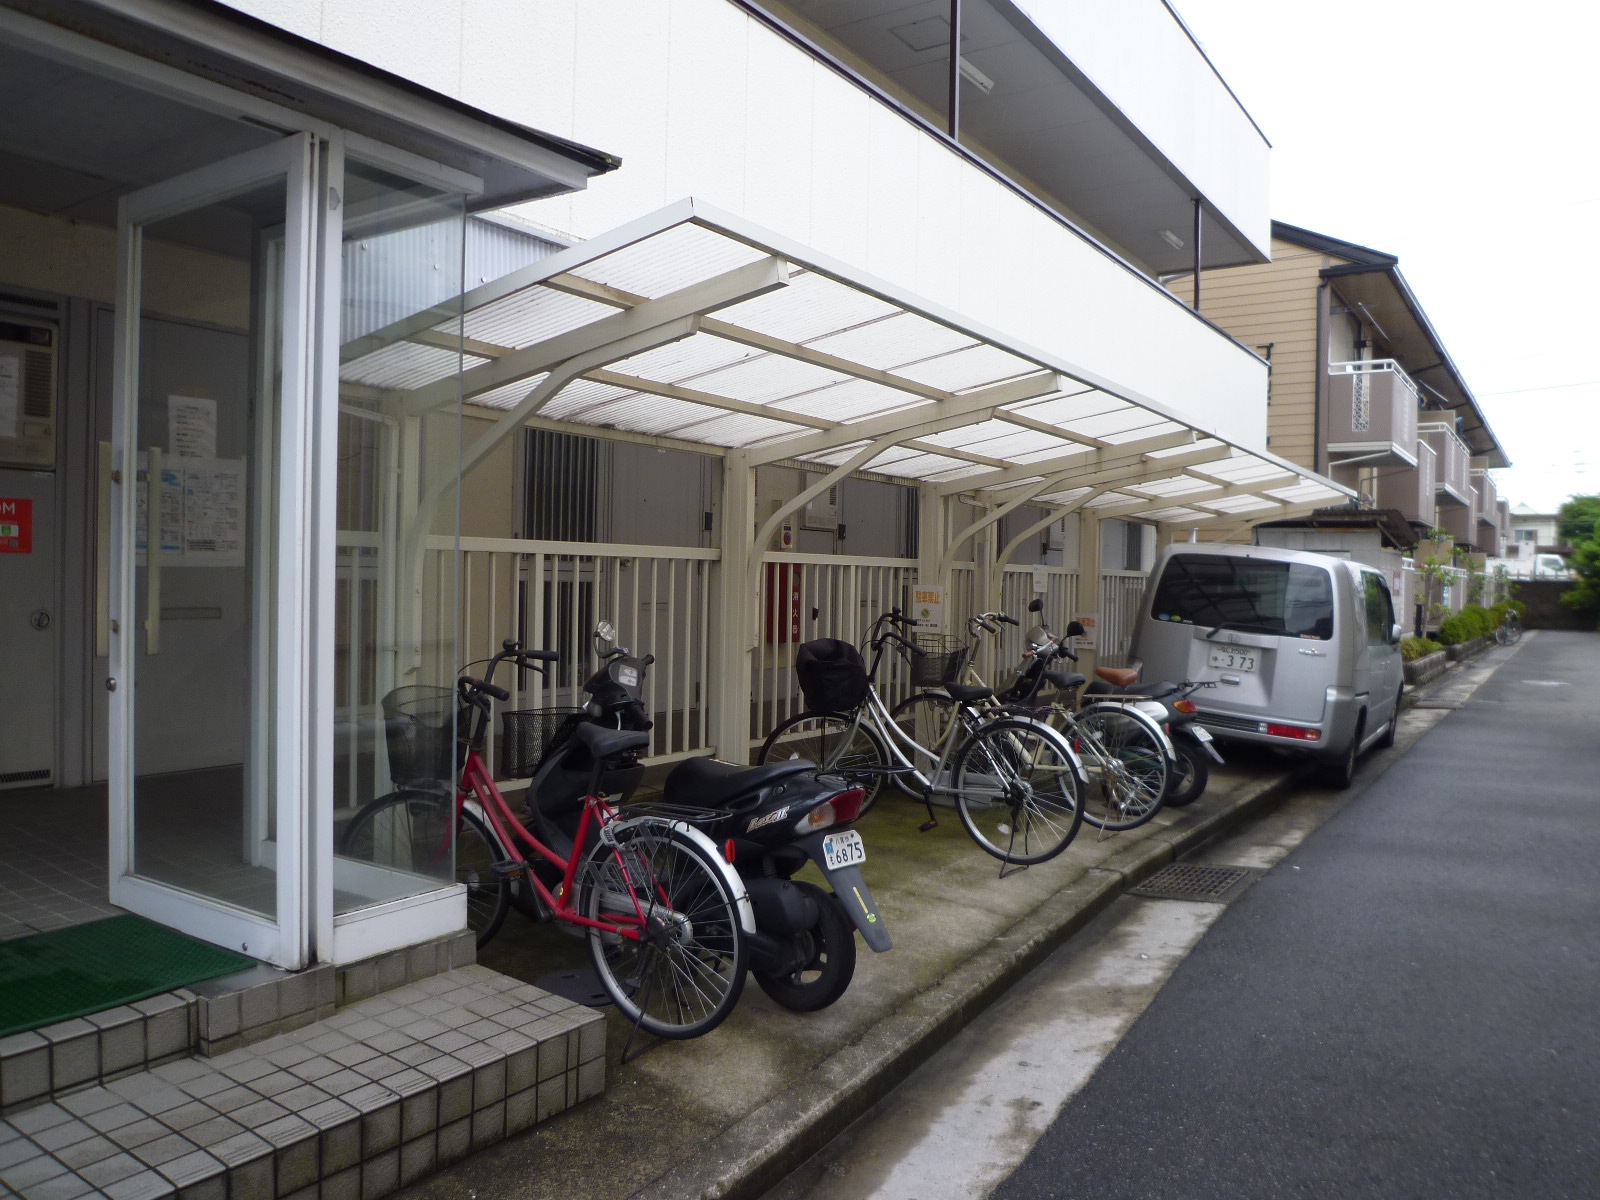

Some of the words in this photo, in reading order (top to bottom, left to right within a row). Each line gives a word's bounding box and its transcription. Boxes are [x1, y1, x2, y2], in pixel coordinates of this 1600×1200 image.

[915, 591, 940, 604] 駐車禁止
[836, 841, 862, 863] 6875
